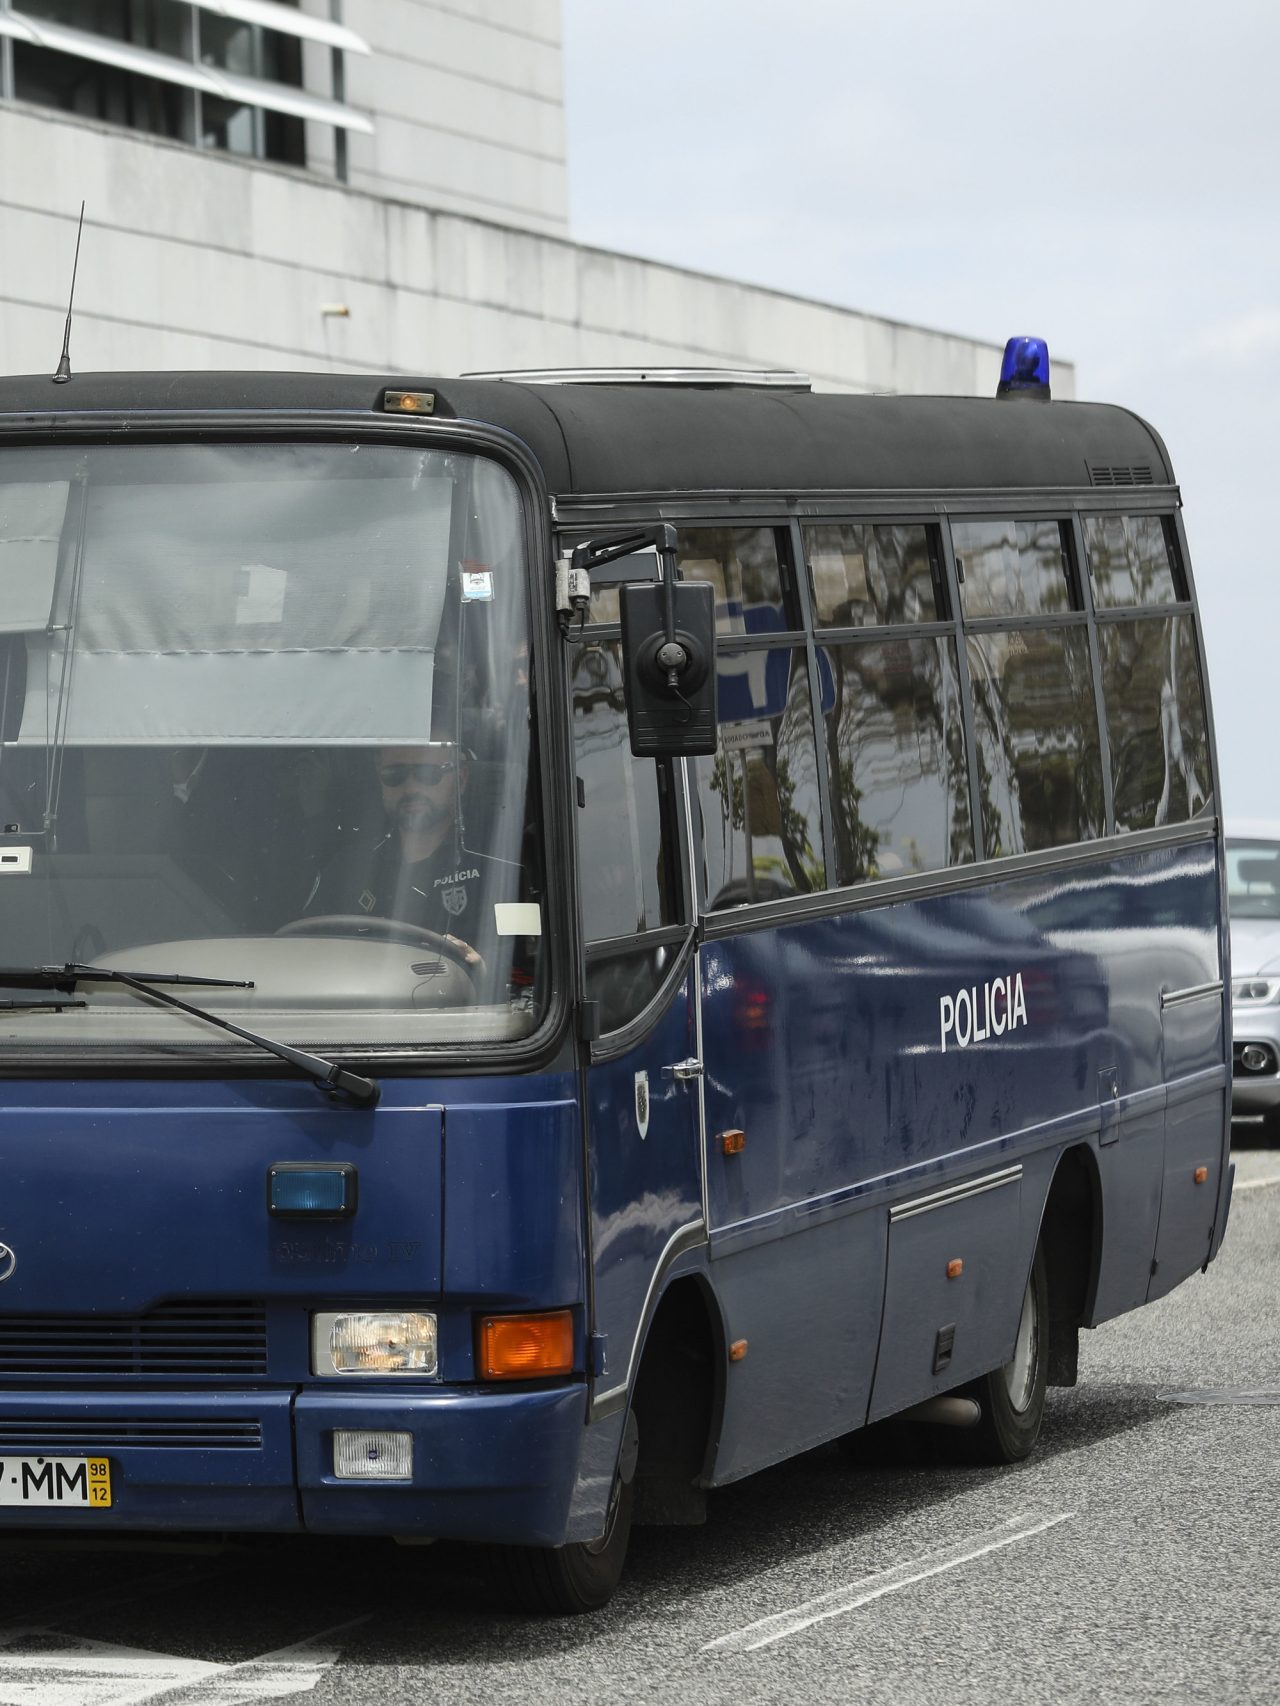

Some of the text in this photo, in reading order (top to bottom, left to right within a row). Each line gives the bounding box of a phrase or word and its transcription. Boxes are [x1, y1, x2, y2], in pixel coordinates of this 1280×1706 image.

[433, 868, 480, 887] POLÍCIA
[940, 972, 1028, 1053] POLICIA
[90, 1463, 107, 1477] 98
[92, 1487, 108, 1501] 12
